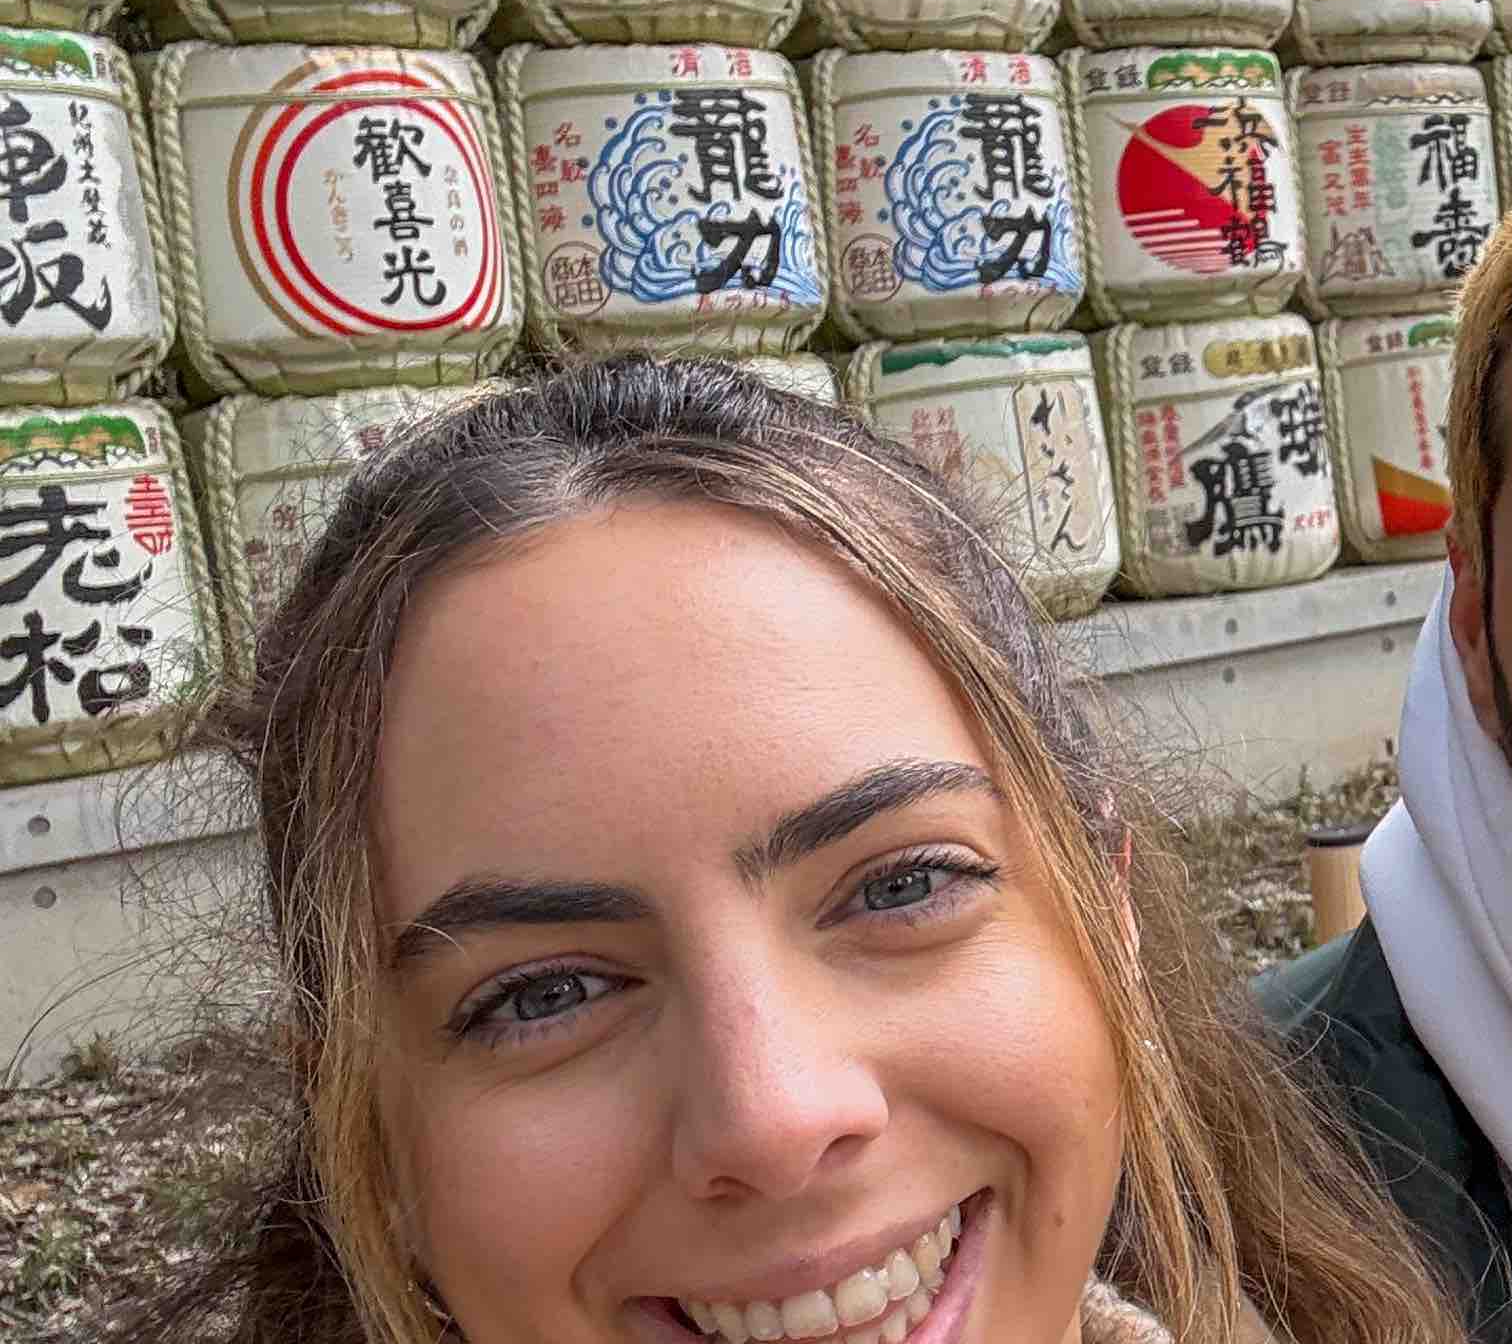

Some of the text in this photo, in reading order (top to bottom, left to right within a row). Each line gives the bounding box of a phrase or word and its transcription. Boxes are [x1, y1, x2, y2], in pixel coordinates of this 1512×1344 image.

[670, 48, 752, 77] 清酒
[962, 52, 1032, 84] 清酒
[352, 115, 447, 307] 歓喜光
[668, 88, 786, 294] 龍力
[959, 92, 1057, 286] 龍力
